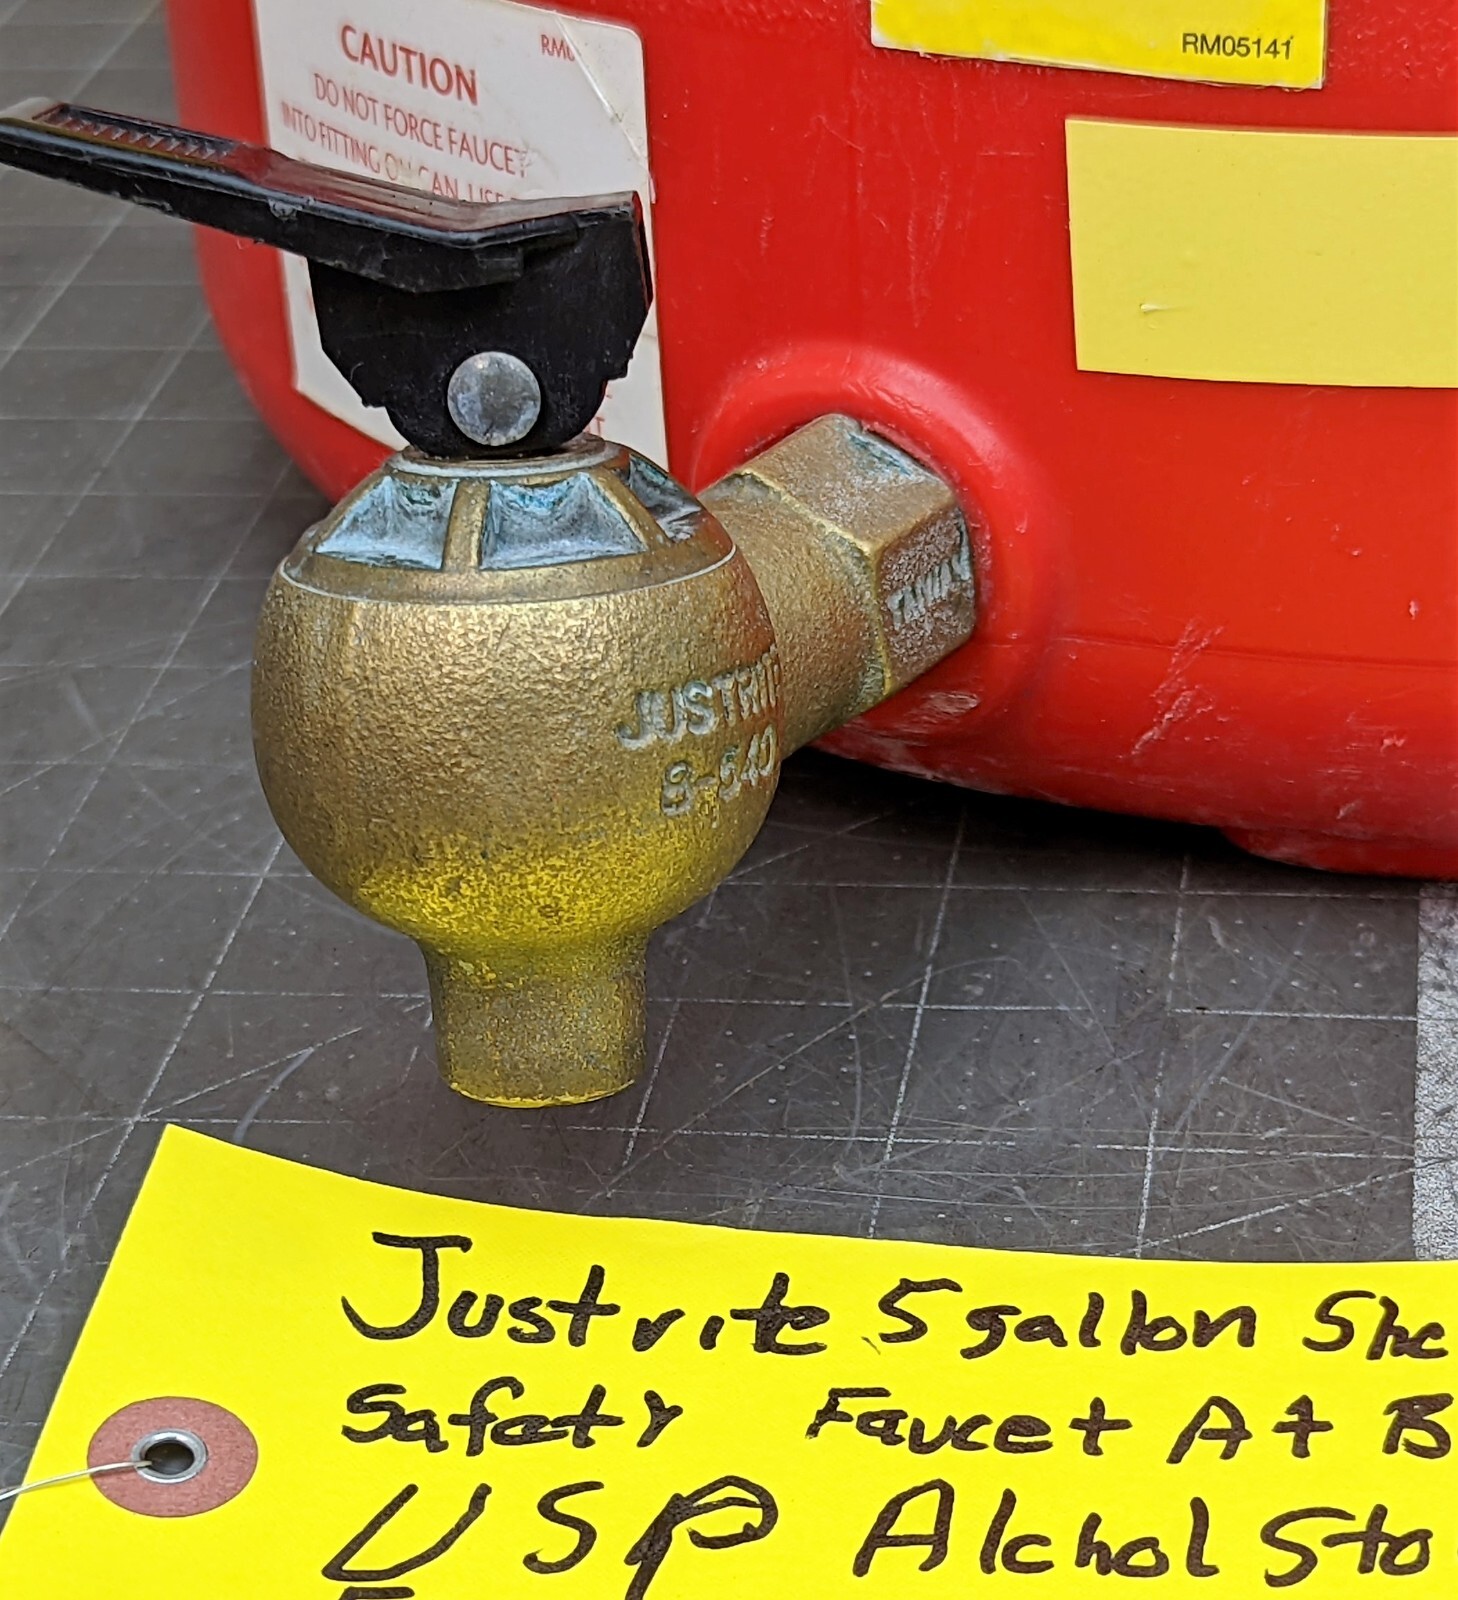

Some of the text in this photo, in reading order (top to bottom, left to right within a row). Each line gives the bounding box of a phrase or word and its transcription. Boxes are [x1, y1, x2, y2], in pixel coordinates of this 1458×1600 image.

[340, 24, 478, 106] CAUTION
[1182, 32, 1293, 60] RM05141
[281, 101, 316, 141] INTO
[319, 121, 380, 173] FITTING
[314, 73, 339, 107] DO
[342, 86, 378, 125] NOT
[384, 103, 444, 151] FORCE
[342, 1232, 830, 1356] Justrite
[878, 1278, 963, 1343] 5
[960, 1290, 1256, 1360] gallon
[806, 1387, 1133, 1457] Faucet
[853, 1478, 1220, 1578] Alchol
[1261, 1503, 1458, 1588] Sto
